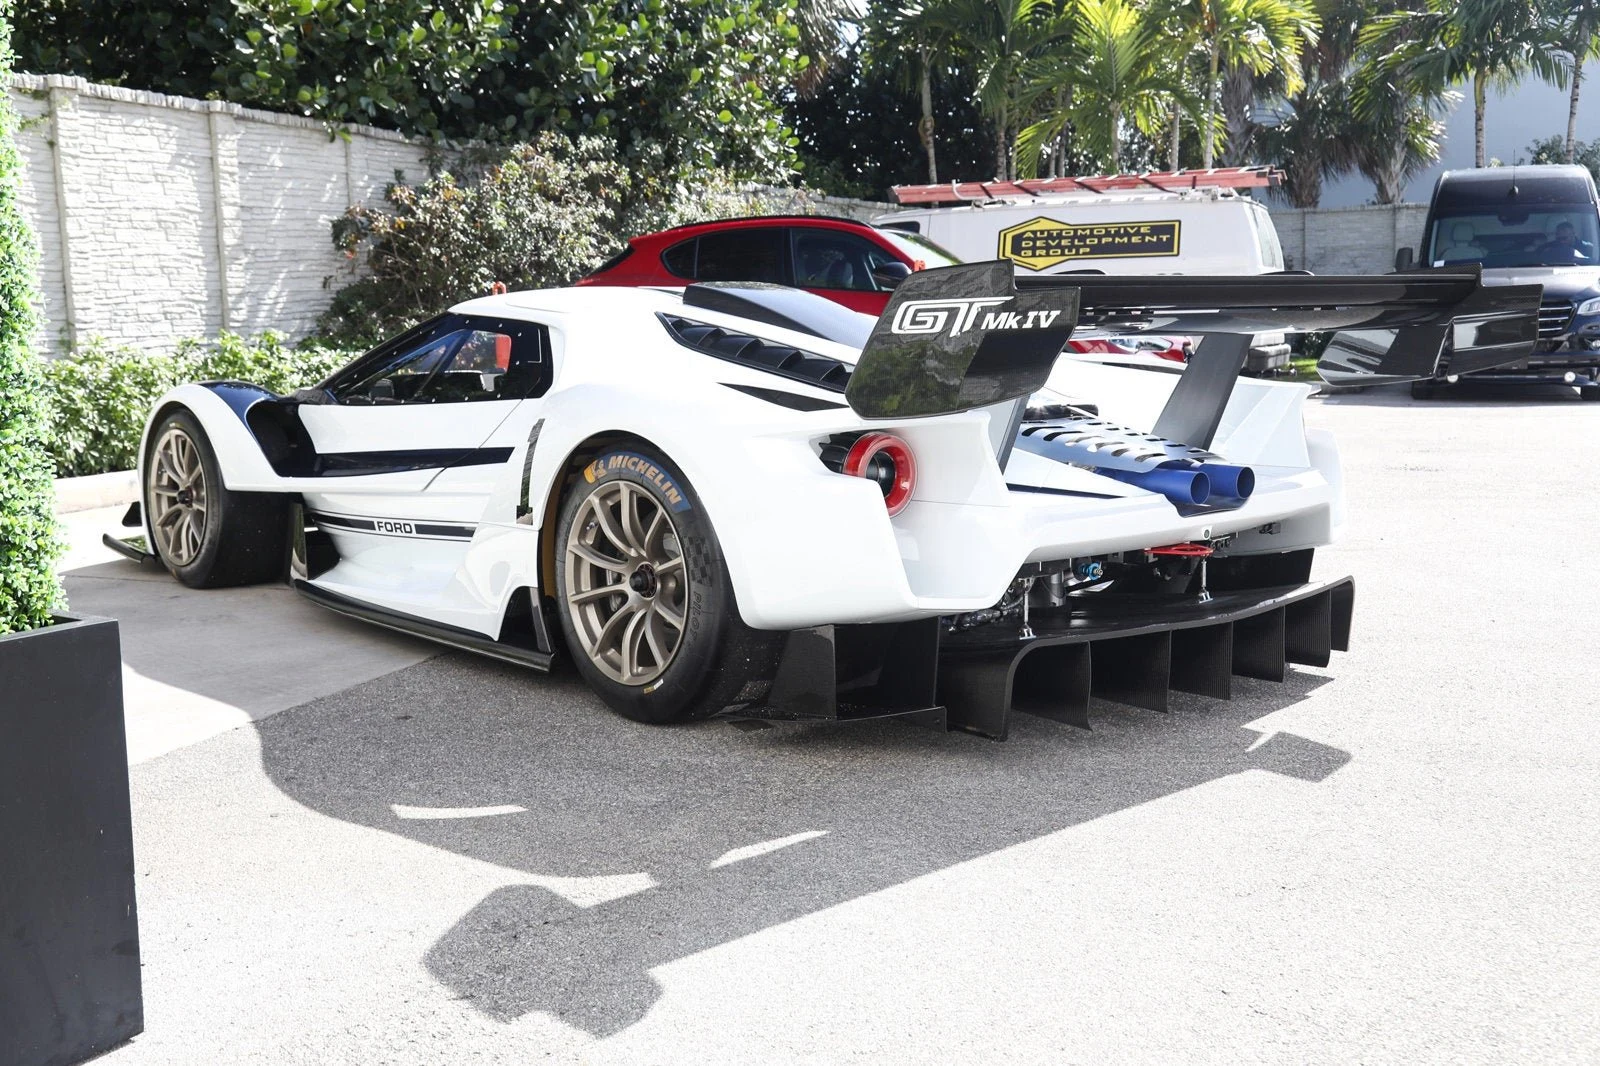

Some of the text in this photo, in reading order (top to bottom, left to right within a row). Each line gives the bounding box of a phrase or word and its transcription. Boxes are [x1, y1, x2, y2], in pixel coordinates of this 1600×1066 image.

[1022, 226, 1151, 238] AUTOMOTIVE
[1021, 234, 1171, 248] DEVELOPMENT
[1021, 247, 1090, 257] GROUP
[891, 296, 1015, 338] GT
[1022, 310, 1062, 329] IV
[608, 455, 682, 505] MICHELIN
[376, 520, 413, 534] FORD
